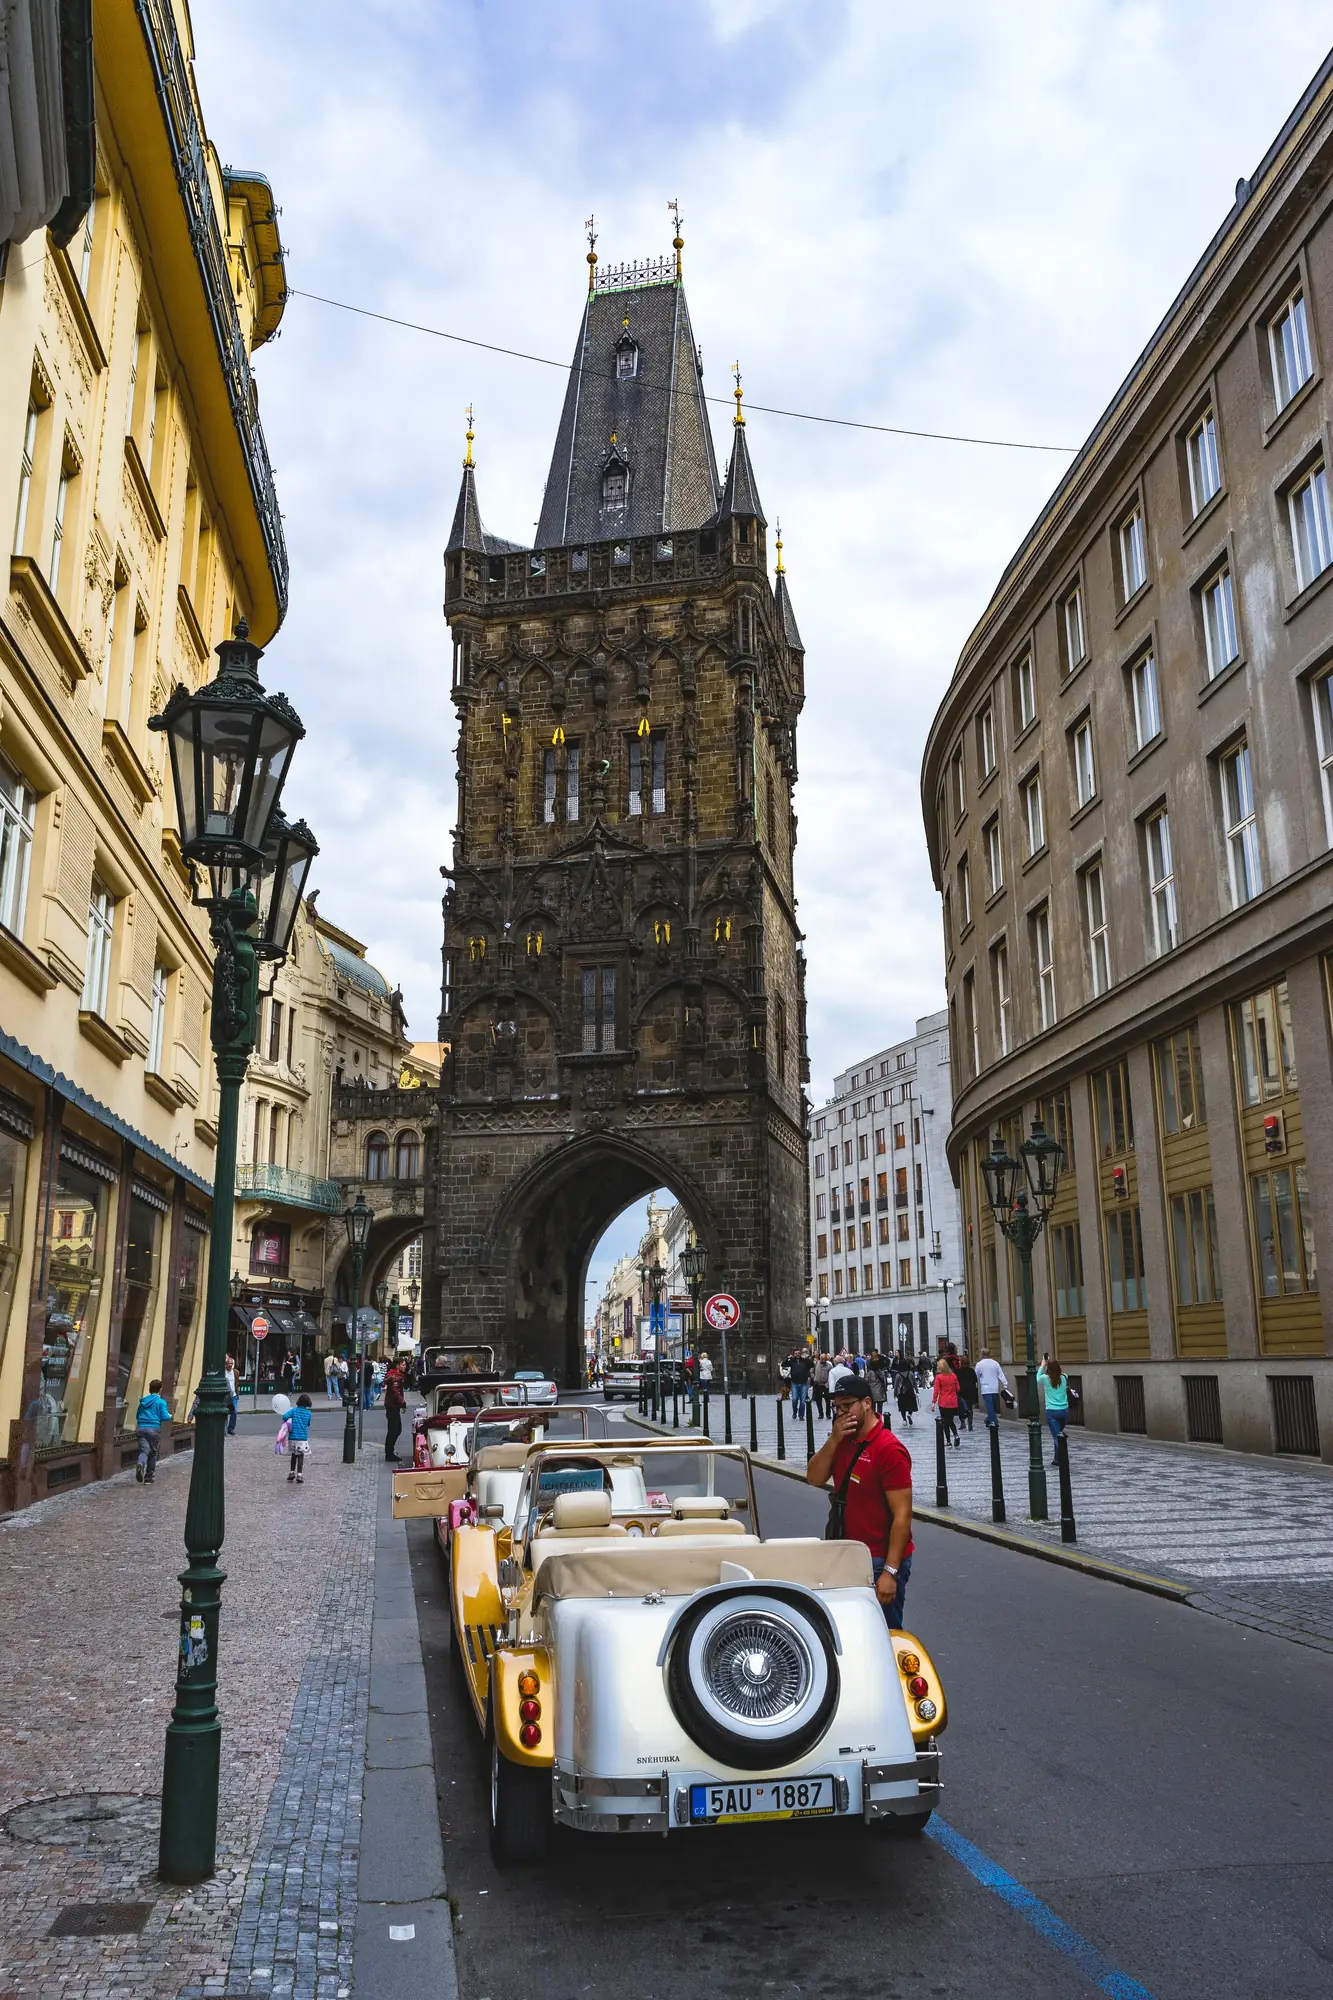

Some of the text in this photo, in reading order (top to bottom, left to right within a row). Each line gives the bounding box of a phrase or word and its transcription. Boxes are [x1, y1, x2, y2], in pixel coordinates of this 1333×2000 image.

[711, 1782, 823, 1814] 5AU 1887
[694, 1807, 705, 1815] CZ
